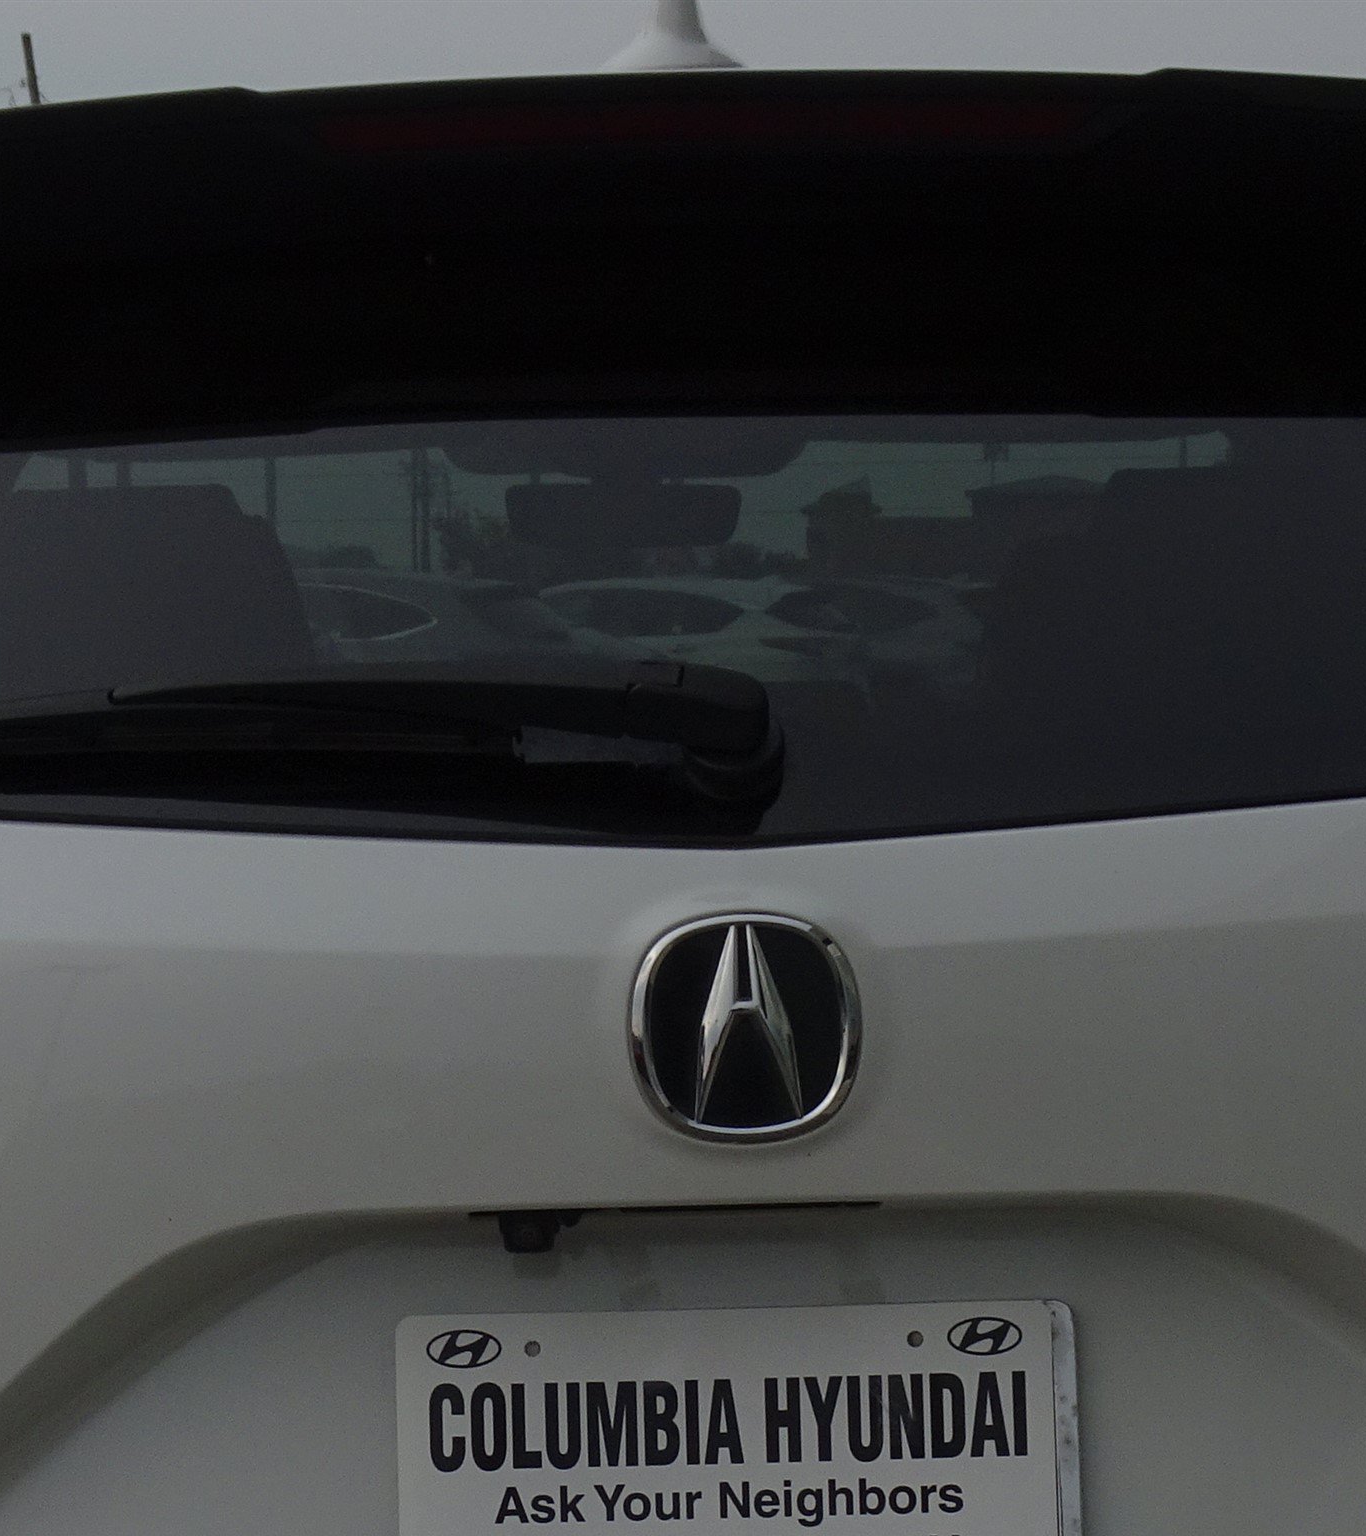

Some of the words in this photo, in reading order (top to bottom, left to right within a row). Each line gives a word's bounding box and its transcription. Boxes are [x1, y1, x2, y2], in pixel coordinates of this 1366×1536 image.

[429, 1379, 744, 1472] COLUMBIA
[764, 1371, 1027, 1463] HYUNDAI
[496, 1486, 585, 1524] Ask
[594, 1485, 702, 1521] Your
[720, 1478, 963, 1527] Neighbors
